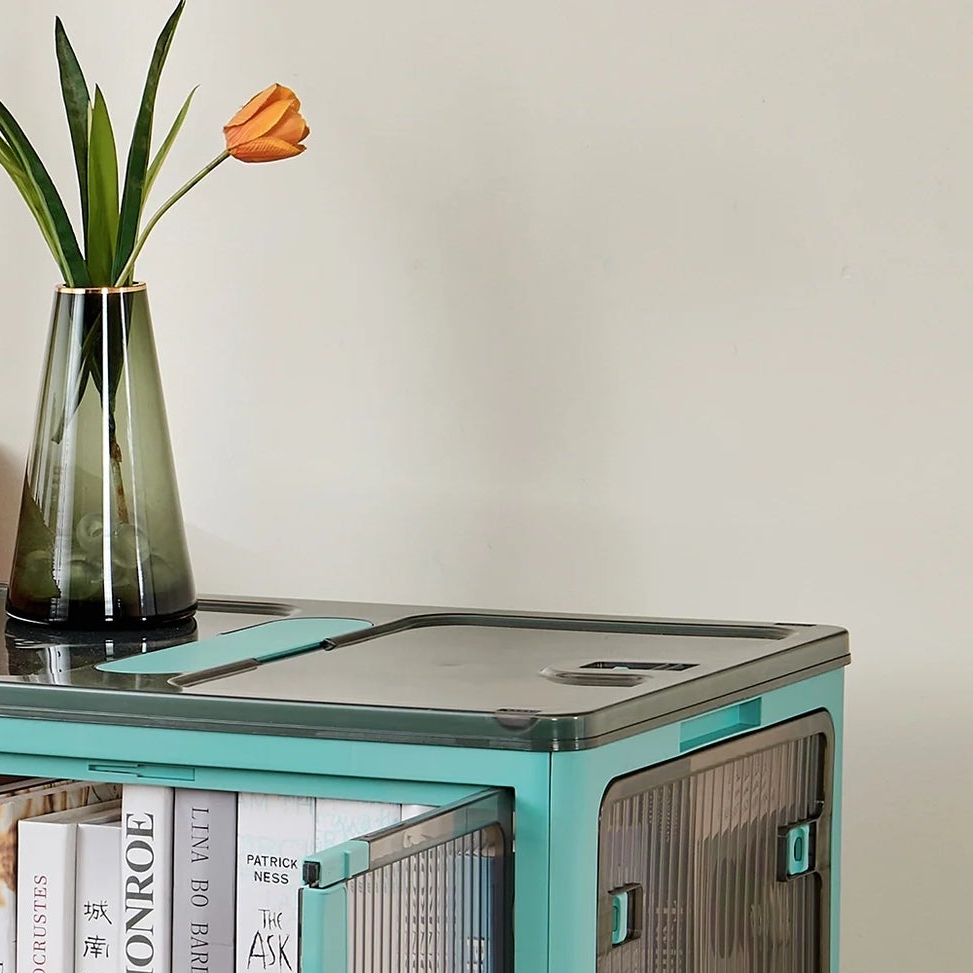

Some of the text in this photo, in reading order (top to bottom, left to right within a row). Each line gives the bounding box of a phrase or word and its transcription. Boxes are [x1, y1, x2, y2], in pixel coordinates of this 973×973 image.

[190, 807, 209, 864] LINA
[247, 854, 299, 870] PATRICK
[254, 871, 290, 885] NESS
[190, 879, 209, 907] BO
[258, 909, 283, 931] THE
[247, 931, 293, 972] ASK
